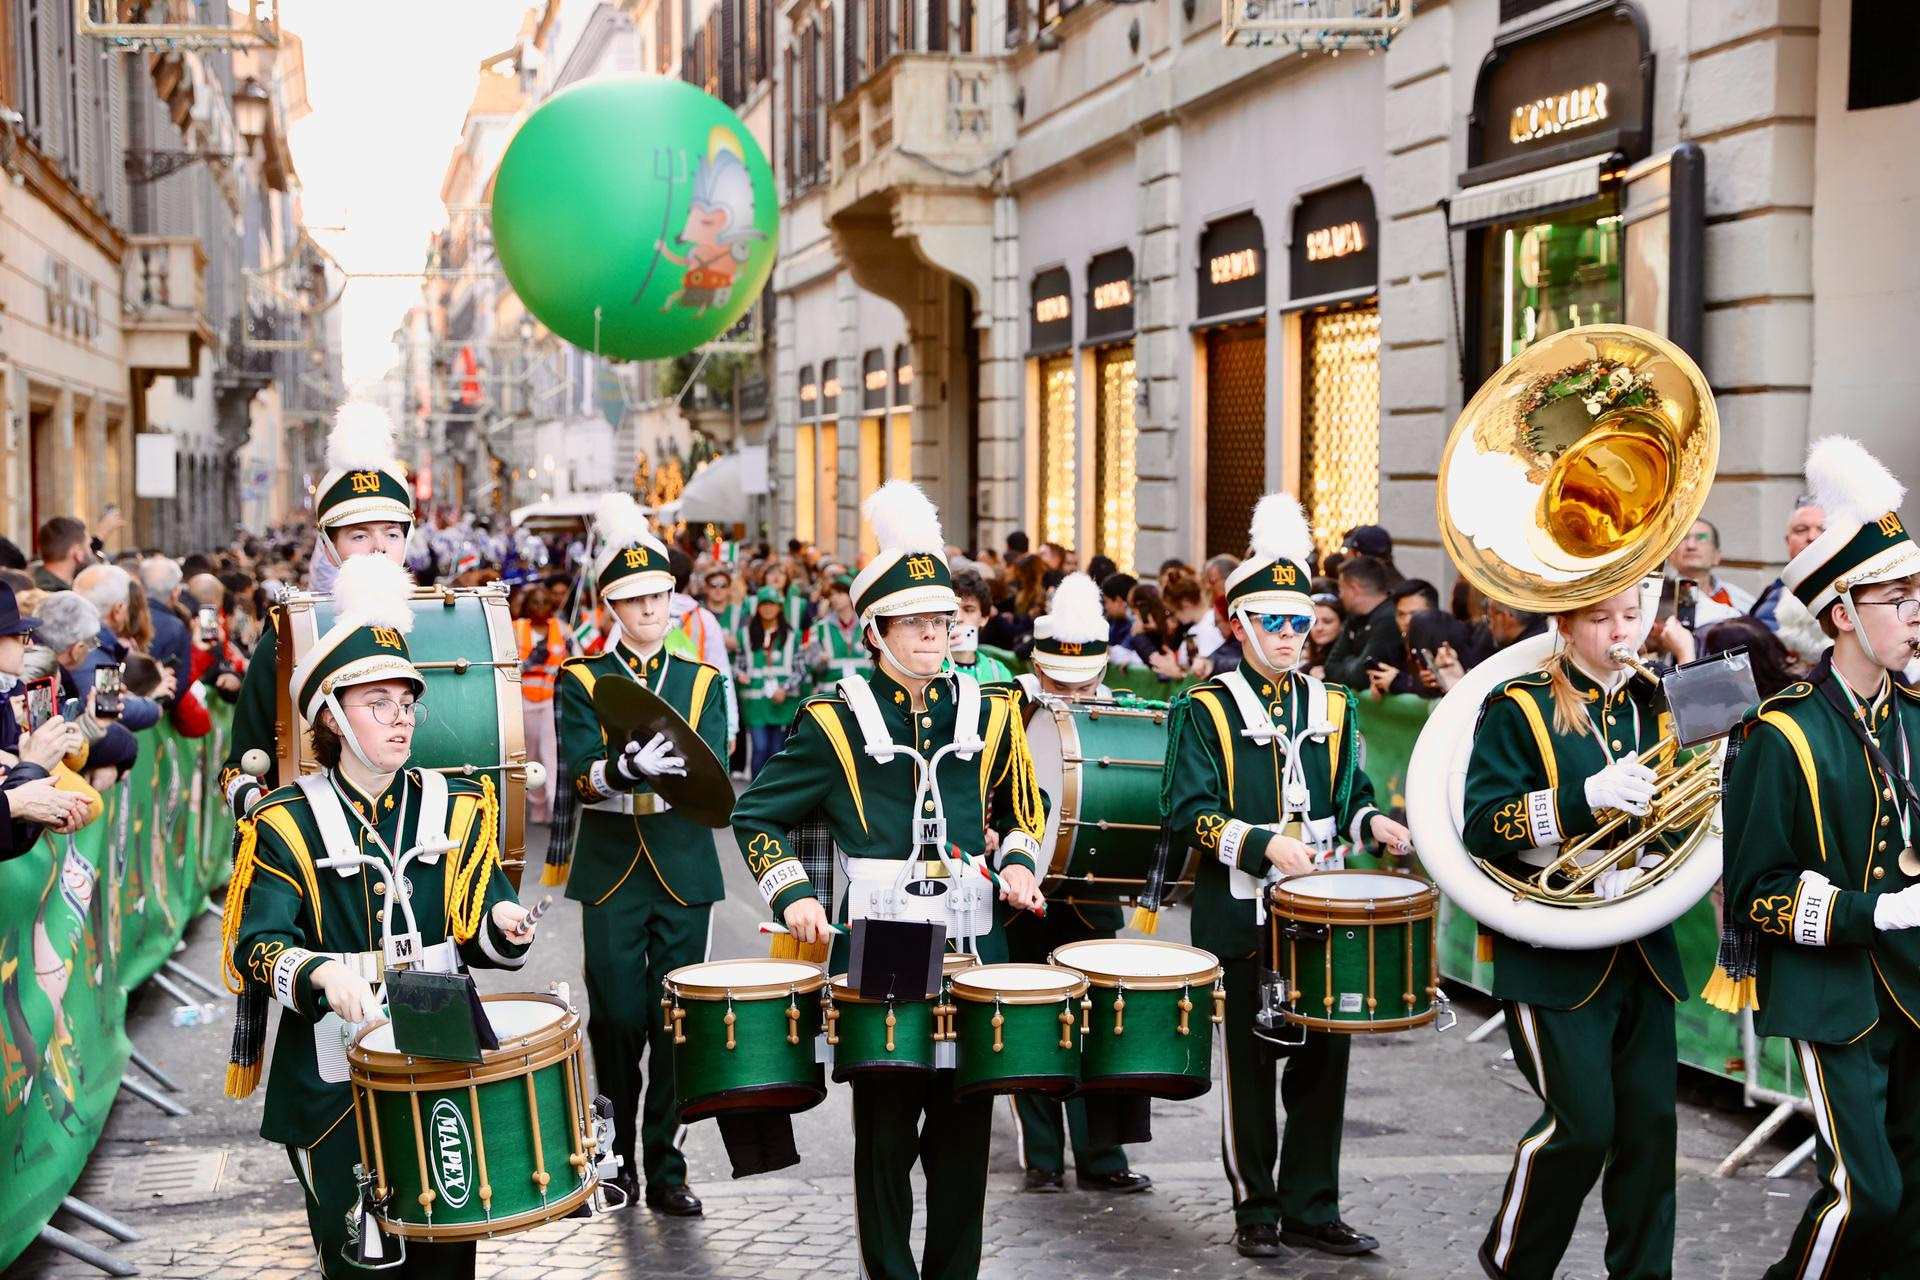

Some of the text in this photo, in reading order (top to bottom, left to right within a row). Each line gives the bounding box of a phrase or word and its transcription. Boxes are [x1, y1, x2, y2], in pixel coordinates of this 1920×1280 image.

[923, 823, 938, 838] M
[1535, 793, 1552, 837] IRISH
[1224, 824, 1243, 860] IRISH
[762, 866, 798, 896] IRISH
[919, 881, 934, 895] M
[1803, 896, 1821, 944] IRISH
[395, 938, 412, 957] M
[279, 950, 306, 997] IRISH
[436, 1114, 466, 1191] MAPEX
